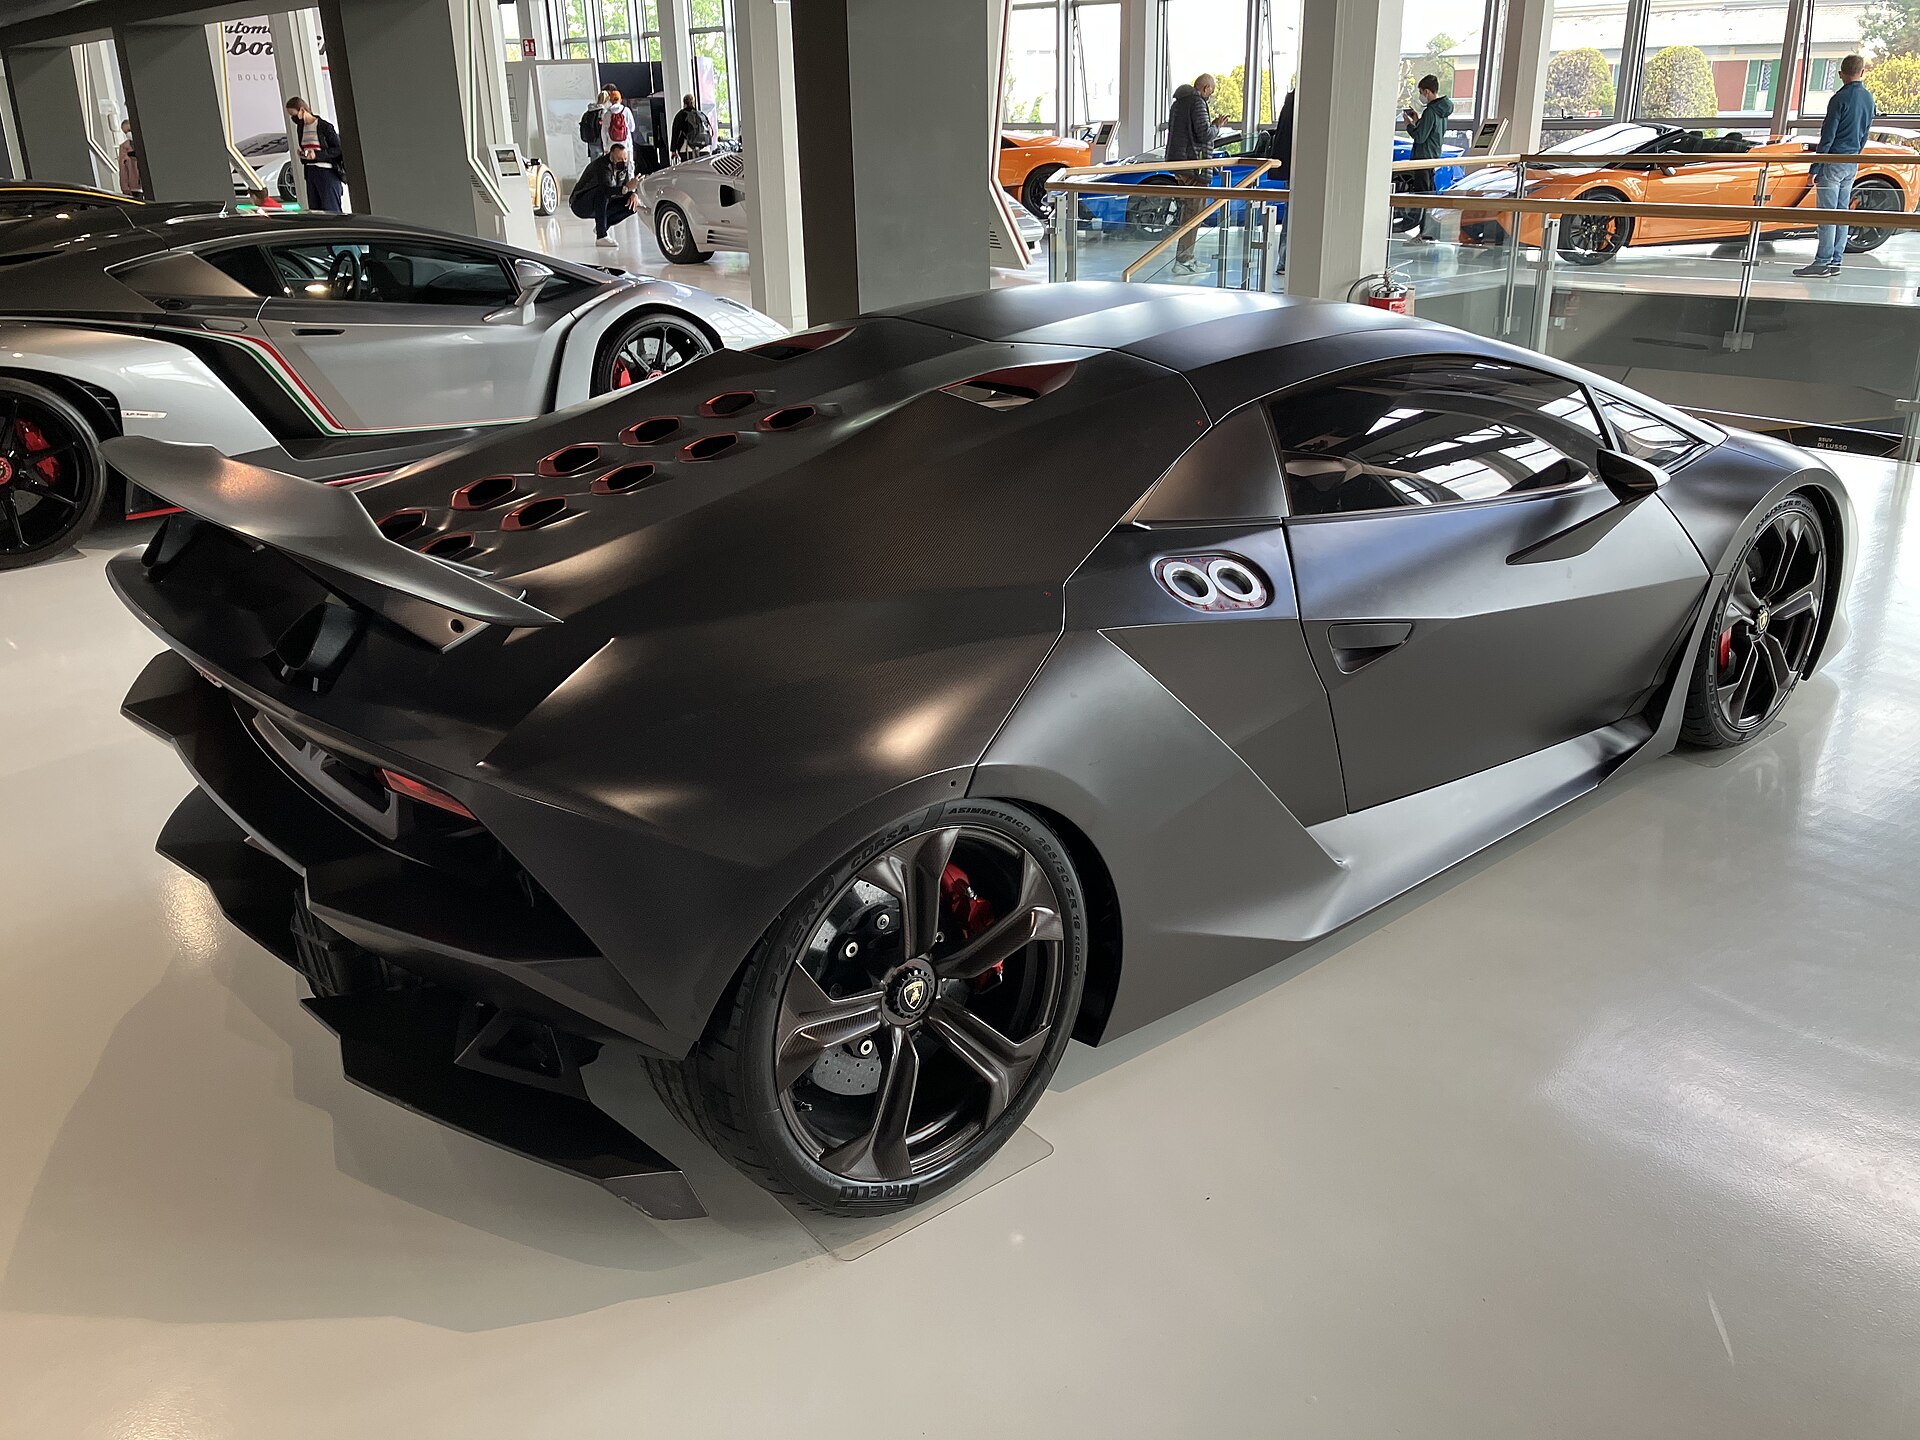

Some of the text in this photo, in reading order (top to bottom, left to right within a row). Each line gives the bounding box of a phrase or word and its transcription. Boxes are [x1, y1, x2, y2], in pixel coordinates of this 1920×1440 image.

[1825, 443, 1848, 451] LUSSO
[1710, 611, 1722, 659] CORSA
[947, 806, 1031, 833] ASIMMETRICO
[850, 823, 912, 870] CORSA
[1065, 885, 1078, 909] ZR
[836, 1183, 921, 1208] PIRELLI
